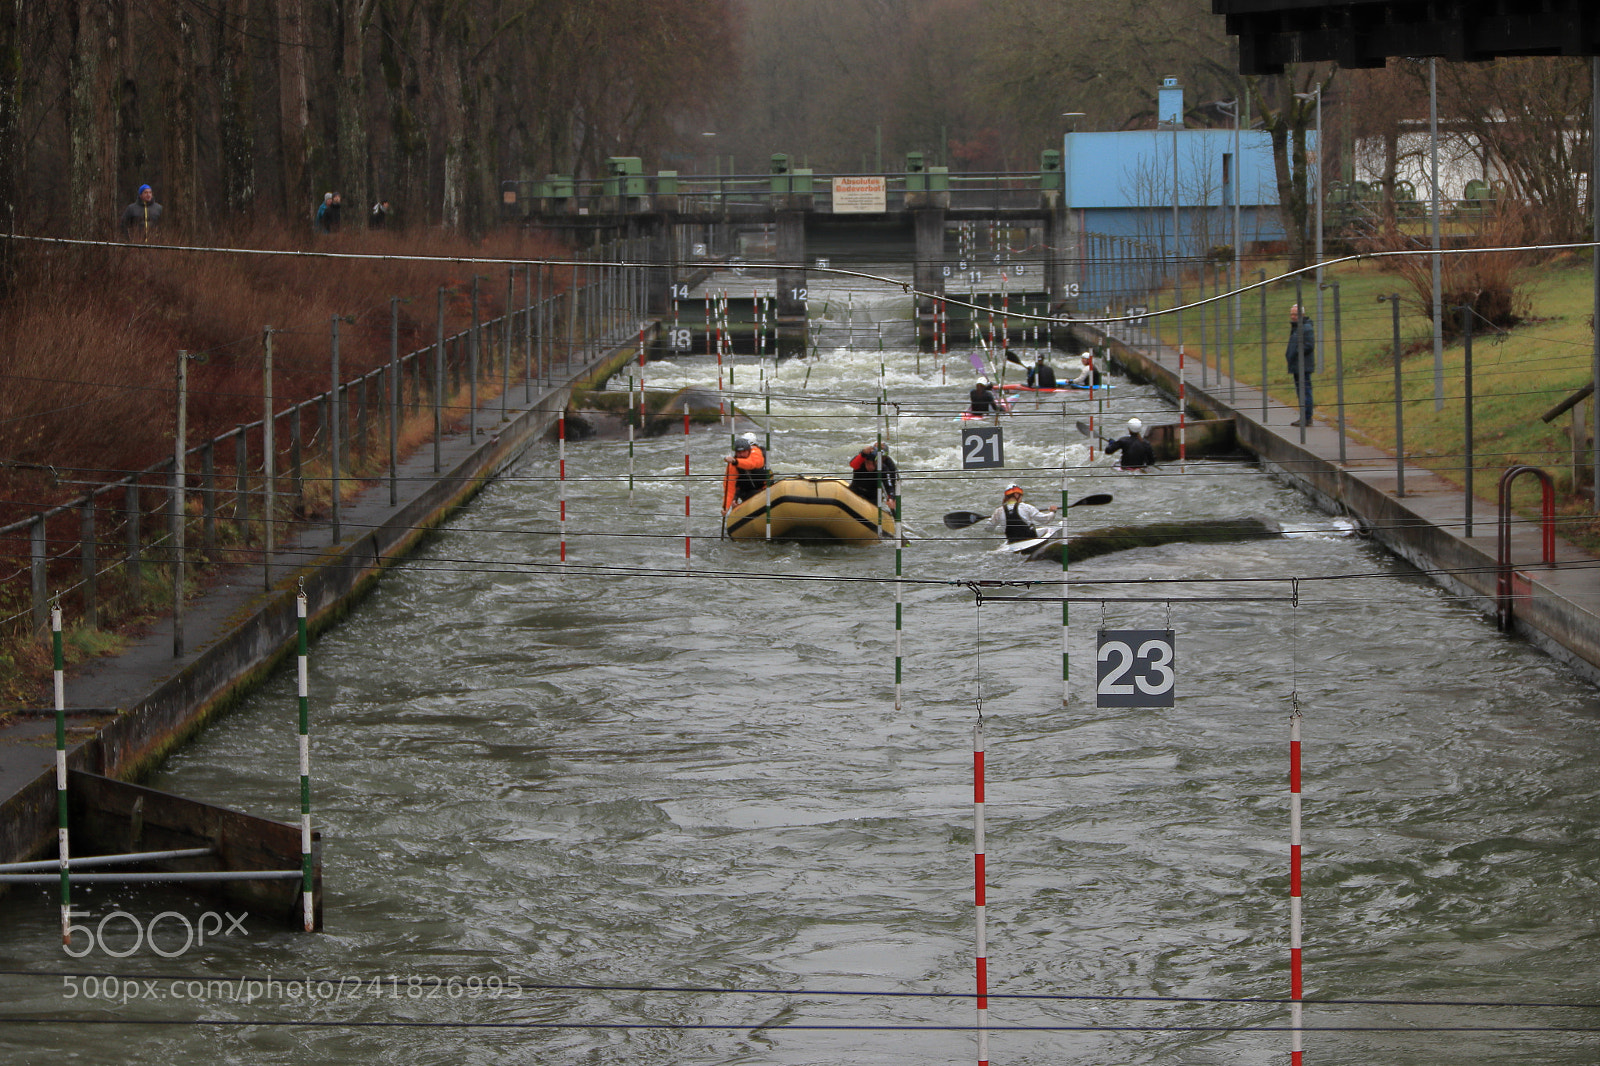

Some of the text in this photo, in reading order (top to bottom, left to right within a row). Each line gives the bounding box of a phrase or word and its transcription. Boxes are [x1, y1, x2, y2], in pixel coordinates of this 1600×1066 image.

[943, 266, 951, 276] 8
[969, 271, 981, 283] 11
[1015, 265, 1024, 276] 9
[671, 284, 689, 298] 14
[791, 287, 808, 300] 12
[1063, 283, 1079, 298] 13
[1126, 307, 1147, 324] 17
[669, 329, 691, 348] 18
[965, 433, 1000, 463] 21
[1097, 639, 1175, 696] 23
